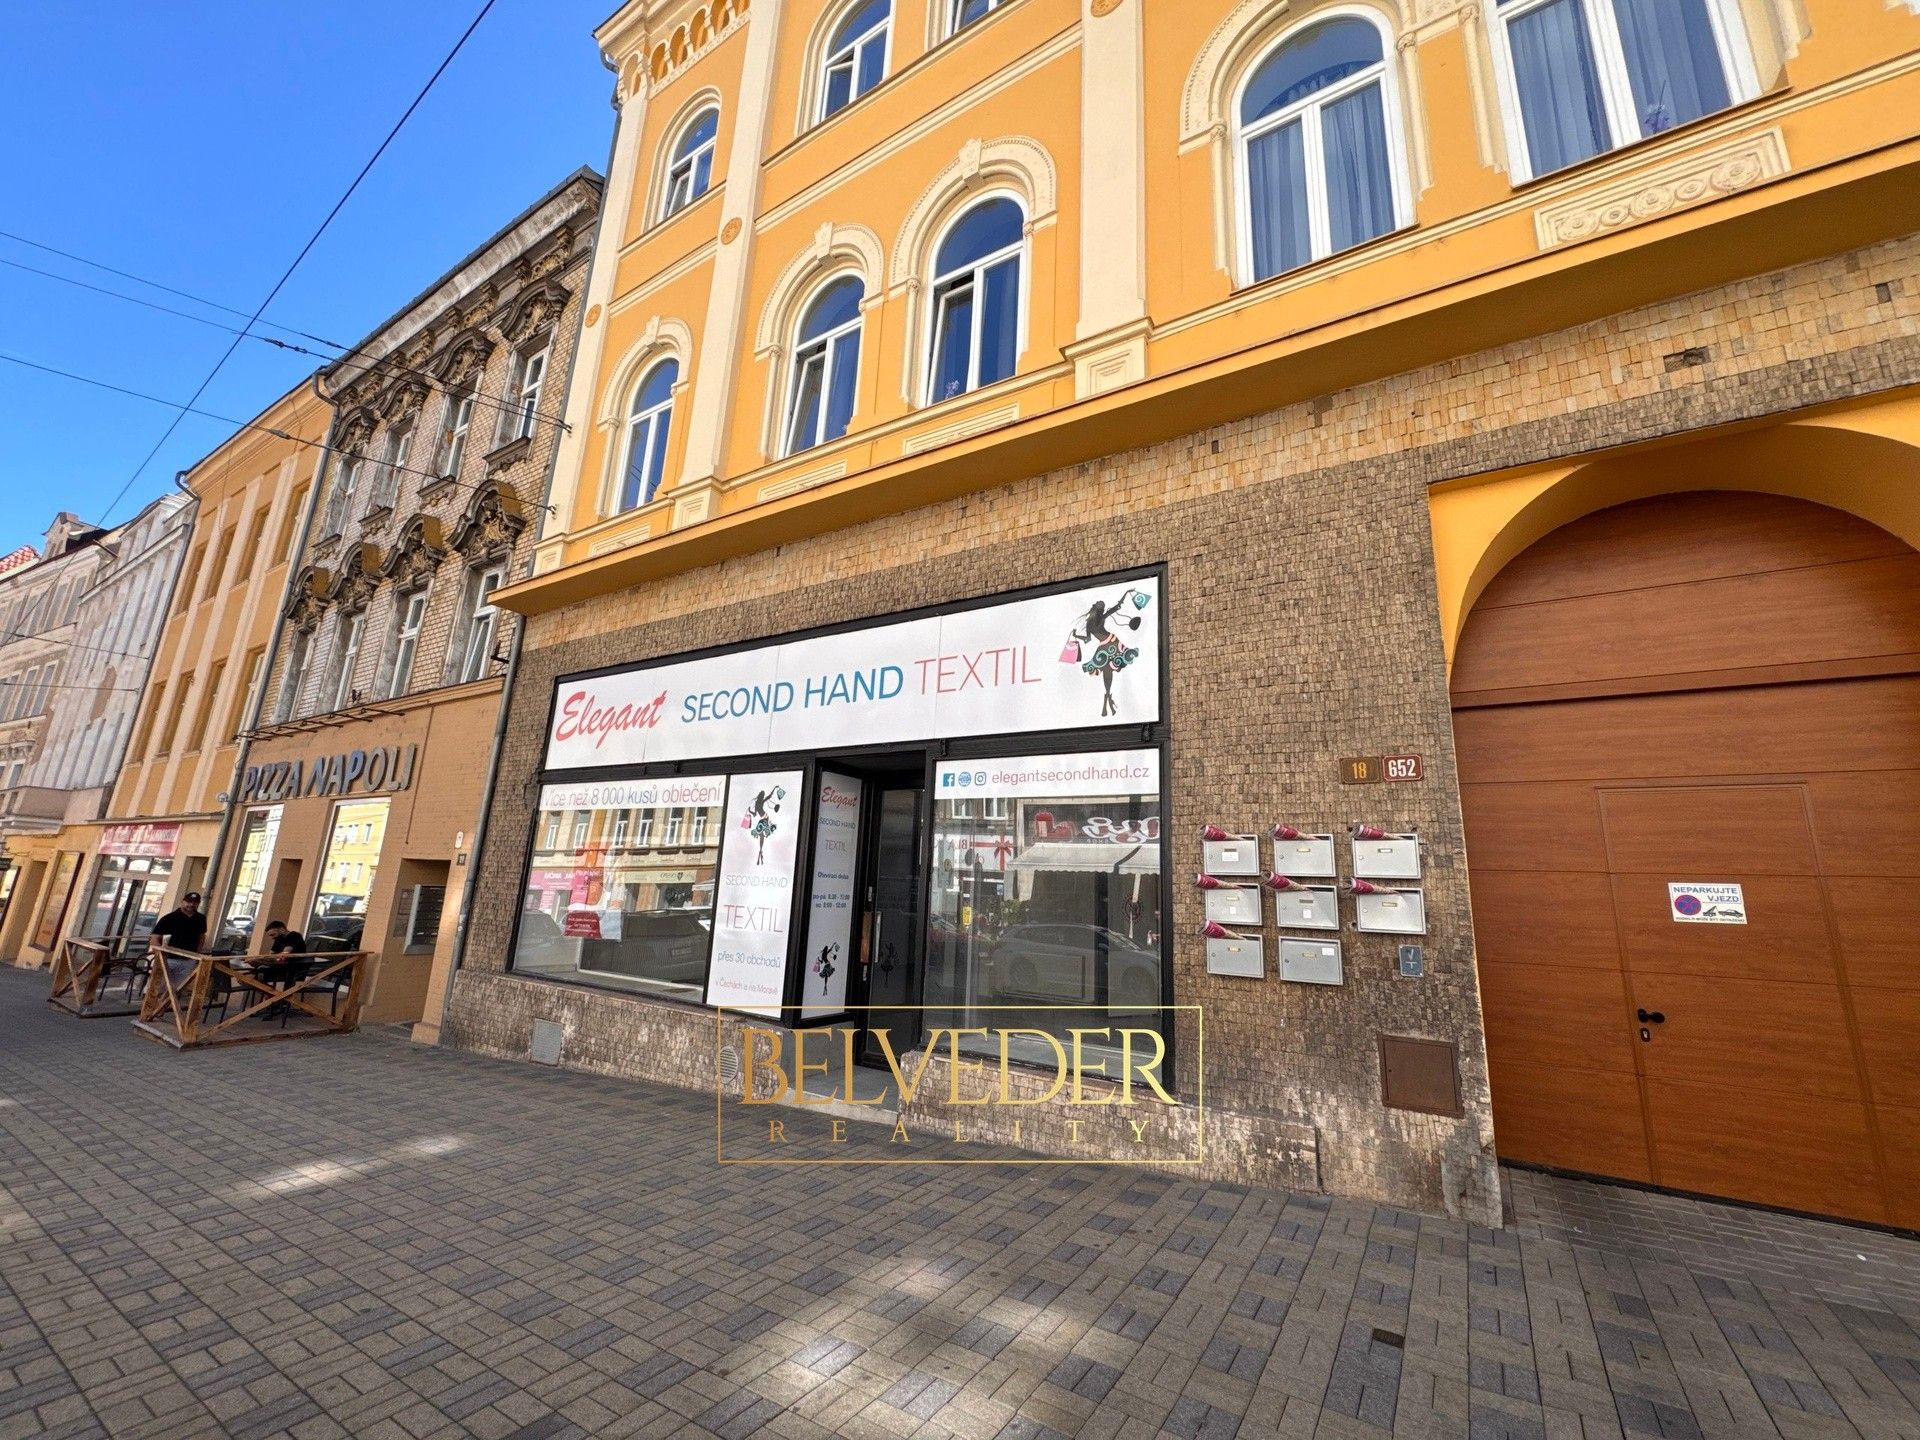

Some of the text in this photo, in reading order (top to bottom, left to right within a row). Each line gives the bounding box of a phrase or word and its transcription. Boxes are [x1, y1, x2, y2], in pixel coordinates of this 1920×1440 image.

[555, 646, 1042, 749] Elegant SECOND HAND TEXTIL
[239, 743, 417, 802] PIZZA NAPOLI
[991, 765, 1150, 785] elegantsecondhand.cz
[1351, 761, 1367, 779] 18
[1387, 758, 1417, 777] 652
[544, 780, 723, 807] Více než 8 000 kusů oblečení
[821, 786, 858, 809] Elegant
[818, 817, 856, 830] SECOND HAND
[825, 839, 847, 853] TEXTIL
[725, 874, 788, 889] SECOND HAND
[1673, 886, 1737, 894] NEPARKUJTE
[723, 904, 784, 933] TEXTIL
[717, 951, 781, 968] přes 30 obchodů
